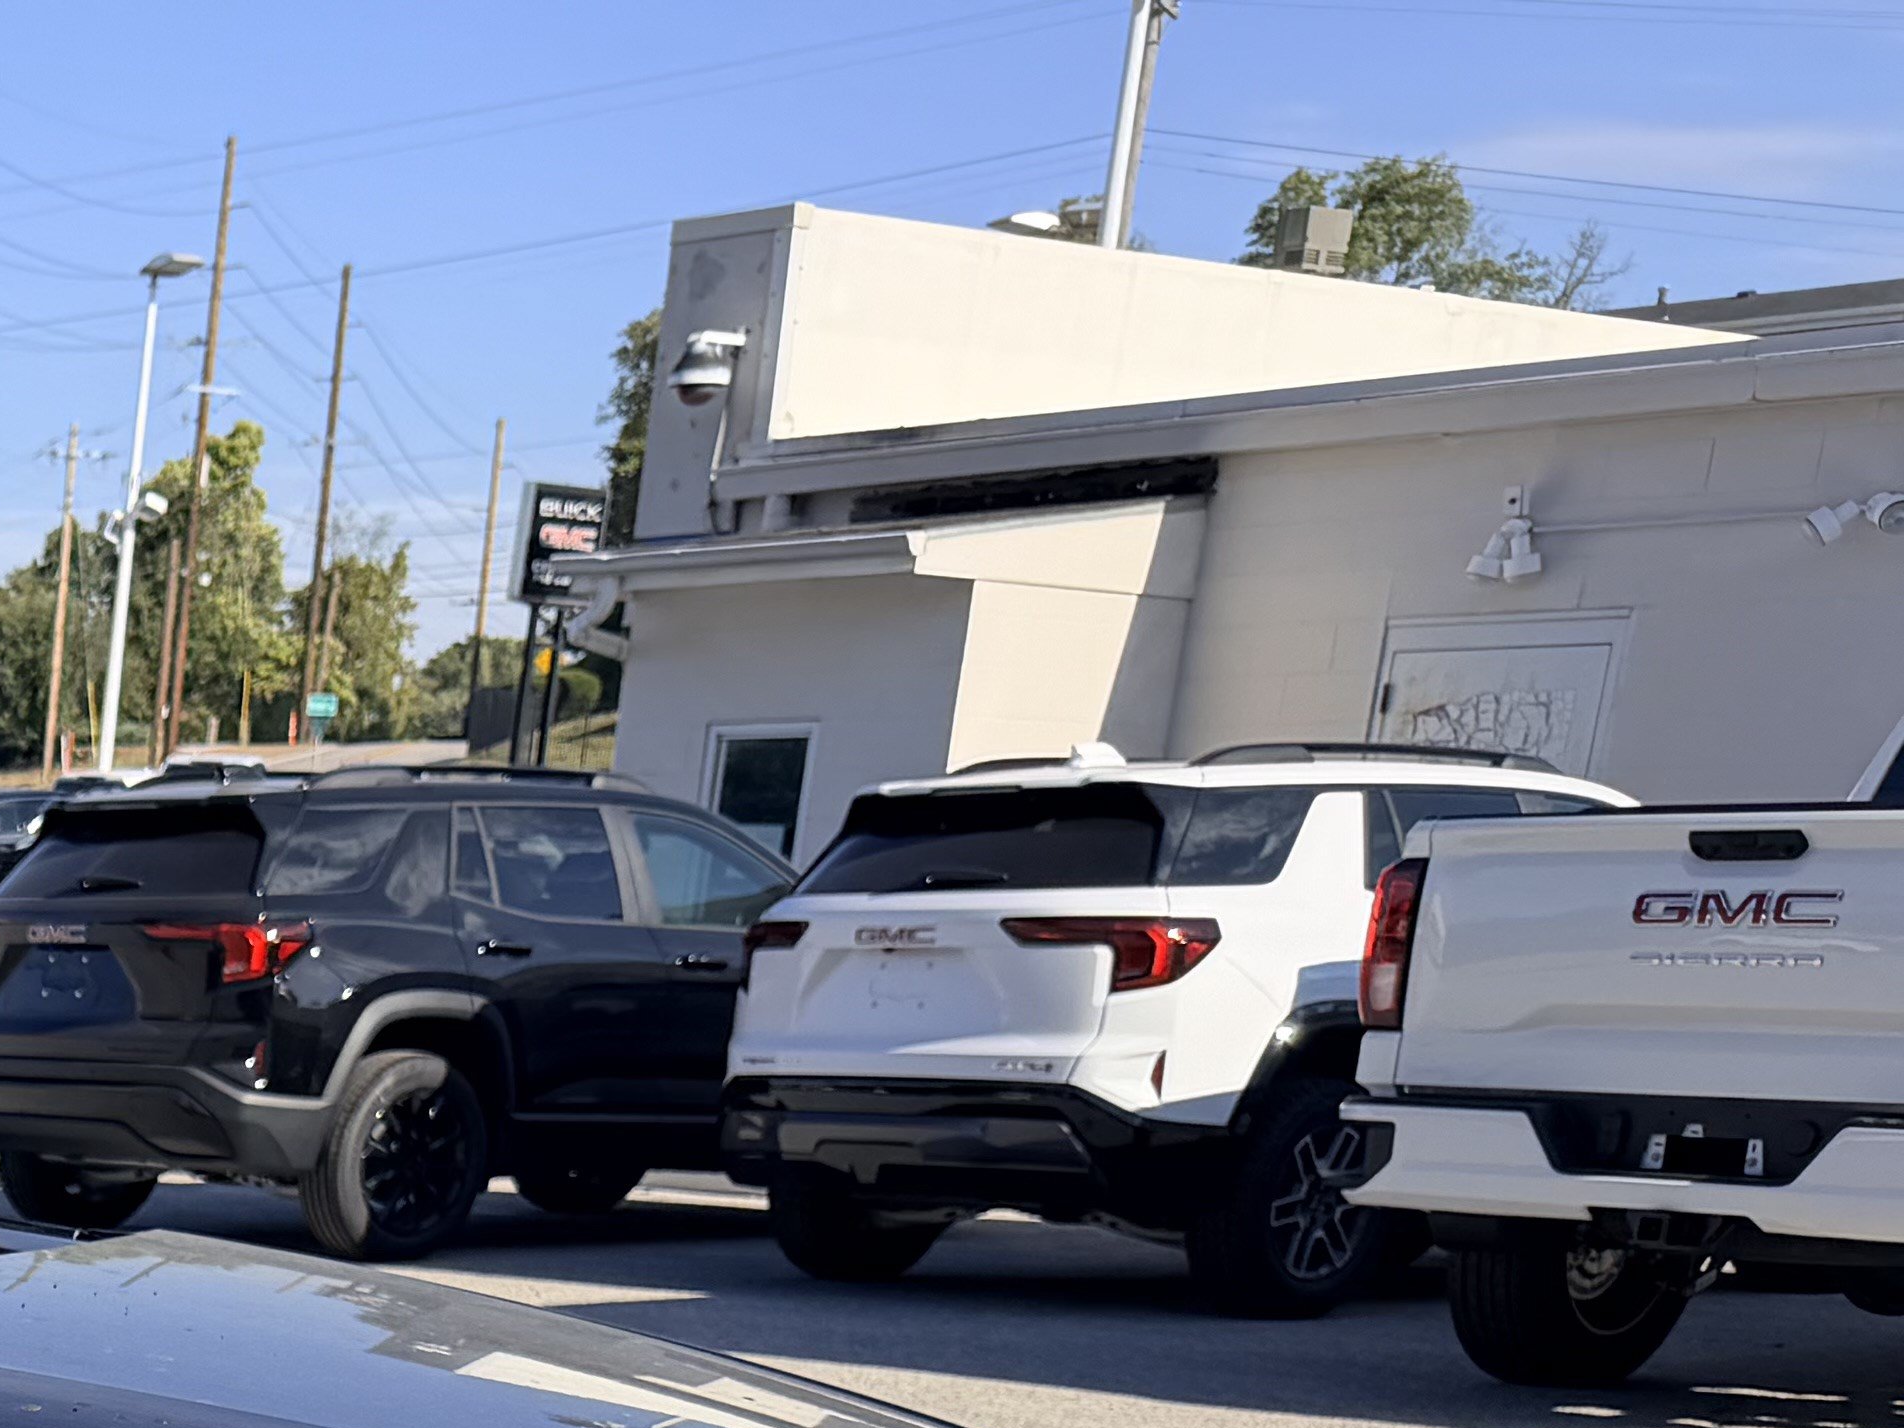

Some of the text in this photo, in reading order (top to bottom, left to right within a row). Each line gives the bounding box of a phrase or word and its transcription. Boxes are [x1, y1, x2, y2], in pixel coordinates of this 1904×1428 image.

[539, 498, 604, 522] BUICK
[539, 523, 598, 552] GMC
[1632, 888, 1845, 928] GMC
[26, 923, 88, 944] GMC
[853, 924, 938, 946] GMC
[1629, 952, 1825, 967] SIERRA
